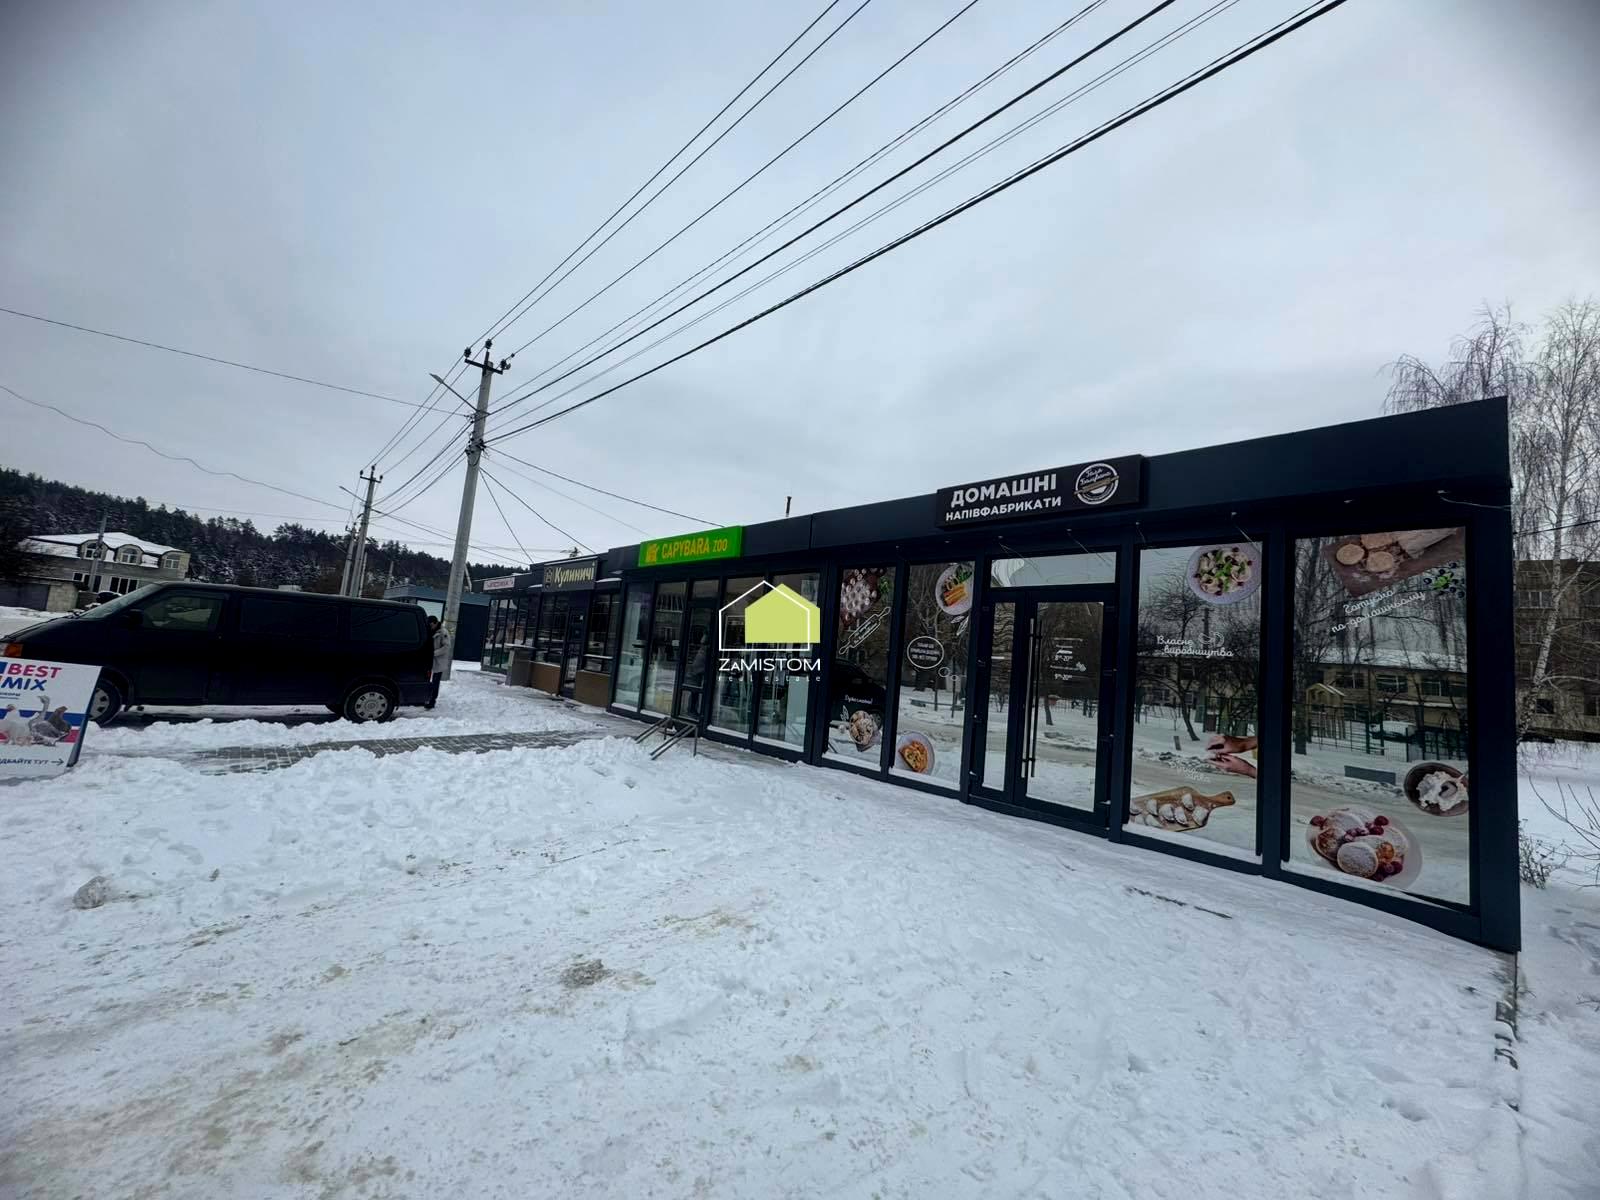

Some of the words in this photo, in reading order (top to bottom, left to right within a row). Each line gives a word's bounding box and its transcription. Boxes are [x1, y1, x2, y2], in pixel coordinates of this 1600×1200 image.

[951, 474, 1057, 507] ДОМАШНІ
[945, 496, 1061, 521] НАПІВФАБРИКАТИ
[662, 538, 710, 558] CAPYBARA
[554, 561, 595, 587] Кулиничі
[1156, 634, 1194, 645] Власне
[7, 663, 62, 679] BEST
[1, 676, 47, 691] MIX
